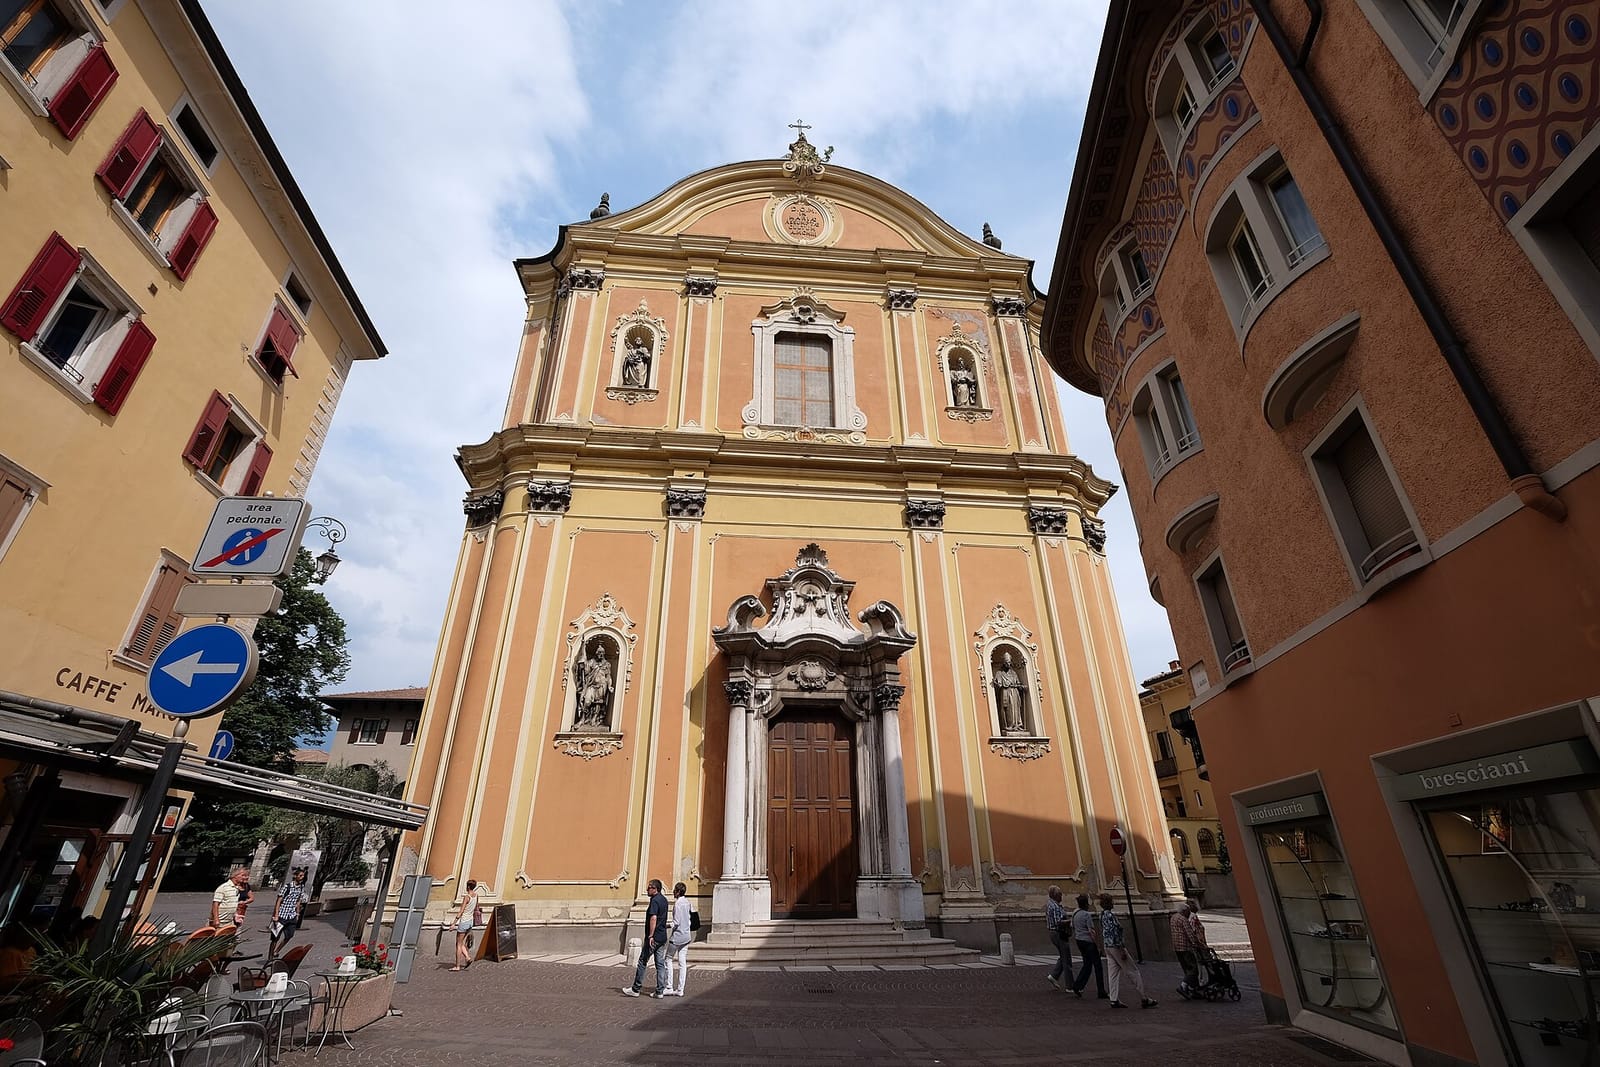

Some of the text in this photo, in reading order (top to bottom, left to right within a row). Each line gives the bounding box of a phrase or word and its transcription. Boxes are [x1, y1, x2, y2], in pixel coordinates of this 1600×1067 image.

[246, 504, 273, 512] area
[226, 515, 282, 525] pedonale
[131, 692, 177, 722] MA
[1418, 755, 1531, 791] bresciani
[1249, 801, 1304, 823] profumeria
